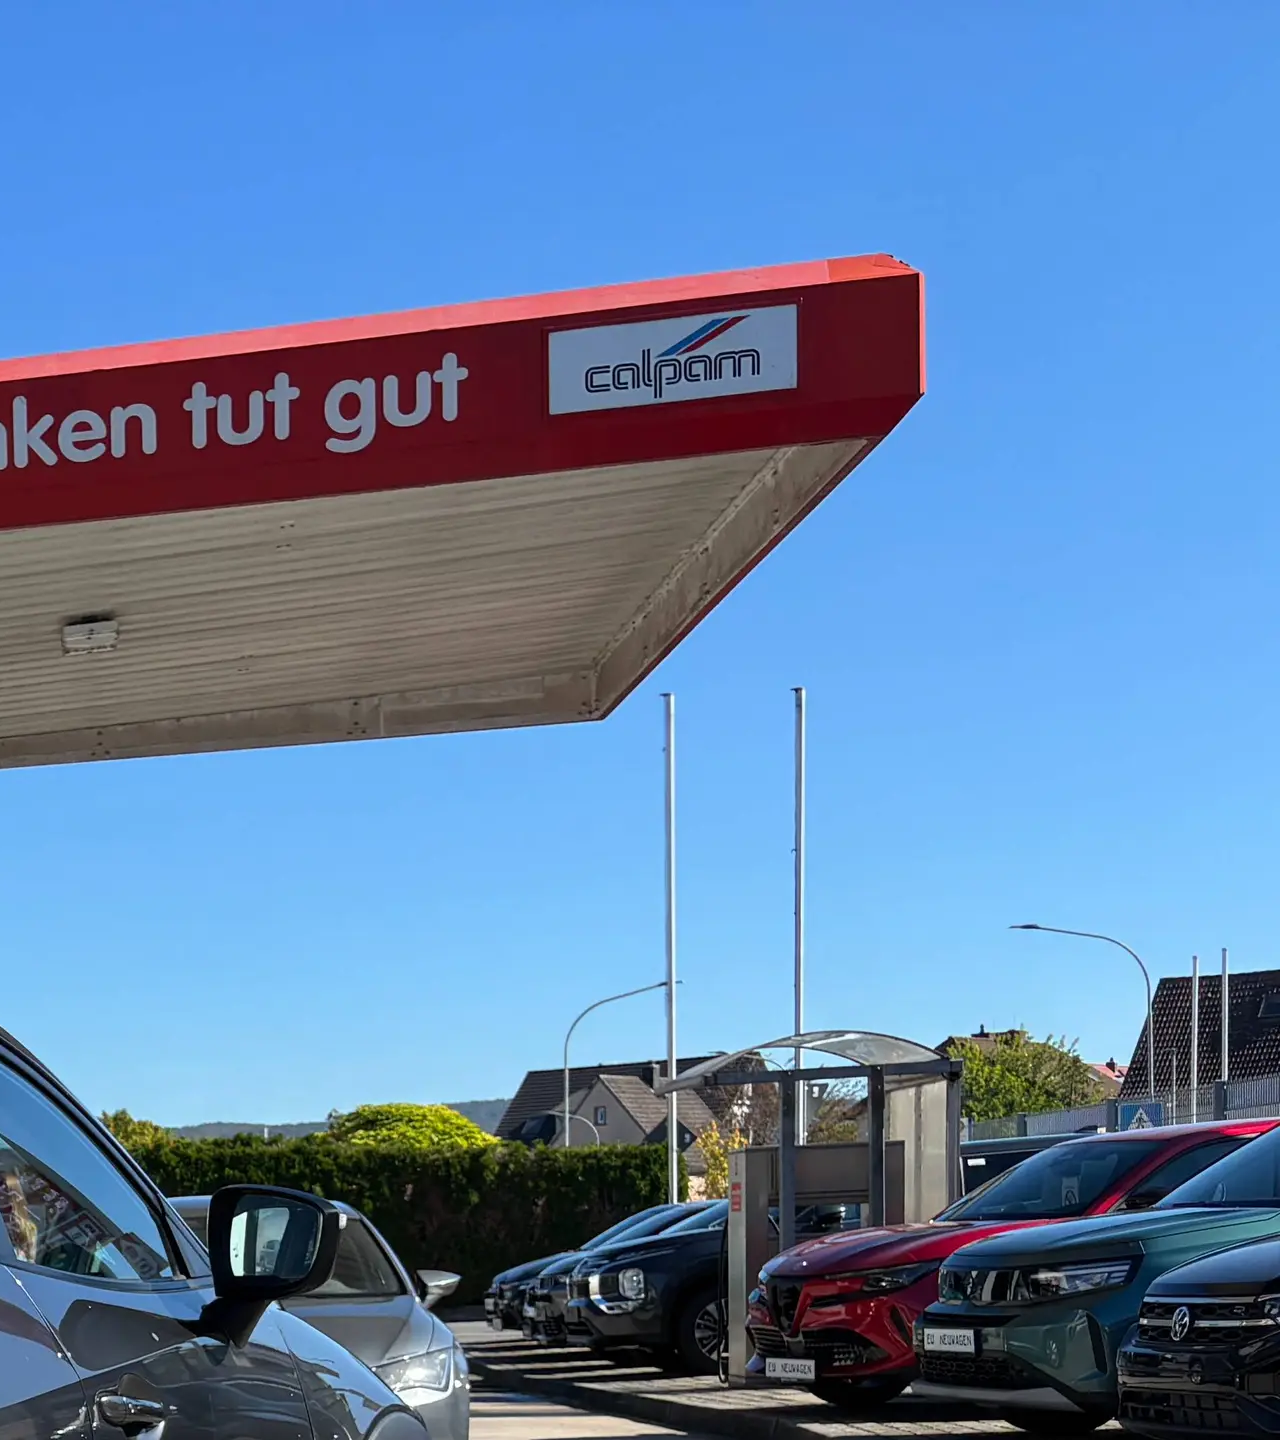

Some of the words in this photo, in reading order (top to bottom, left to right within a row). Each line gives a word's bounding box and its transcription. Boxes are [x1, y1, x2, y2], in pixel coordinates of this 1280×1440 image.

[585, 348, 760, 399] calpam
[182, 371, 302, 451] tut
[323, 351, 470, 454] gut
[926, 1336, 935, 1346] EU
[940, 1335, 972, 1347] NEUWAGEN
[767, 1362, 776, 1373] EU
[781, 1363, 812, 1375] NEUWAGEN
